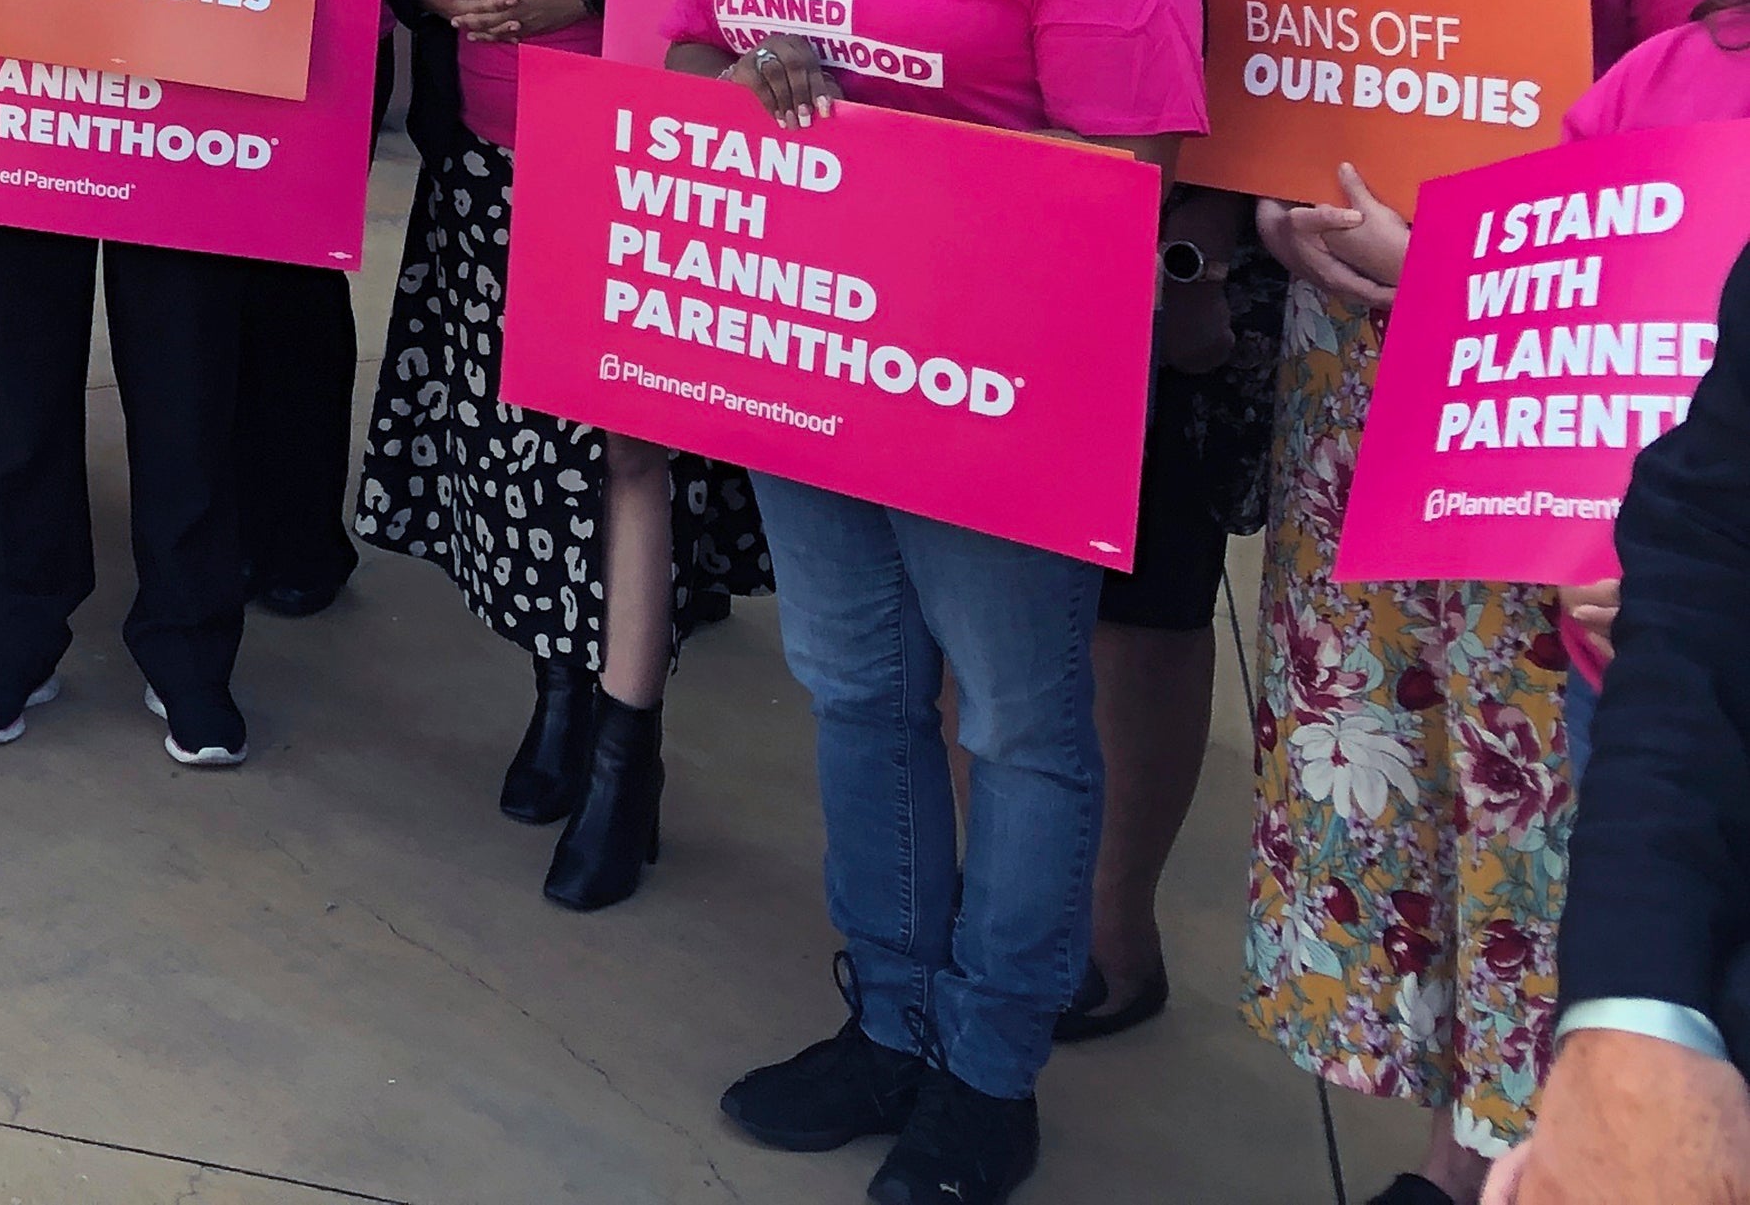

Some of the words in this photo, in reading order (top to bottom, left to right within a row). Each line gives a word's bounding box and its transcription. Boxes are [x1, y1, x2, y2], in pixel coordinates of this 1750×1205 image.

[722, 27, 932, 80] PARTHOOD
[1246, 0, 1360, 53] BANS
[1370, 10, 1461, 60] OFF
[1243, 53, 1343, 105] OUR
[1352, 63, 1542, 128] BODIES
[24, 170, 130, 199] Parenthood
[615, 108, 633, 152] I
[647, 116, 842, 193] STAND
[614, 164, 767, 239] WITH
[1473, 211, 1494, 259] I
[1498, 182, 1684, 253] STAND
[608, 222, 878, 323] PLANNED
[1467, 255, 1601, 321] WITH
[603, 278, 1015, 417] PARENTHOOD
[1448, 322, 1718, 387] PLANNED
[623, 362, 707, 402] Planned
[710, 384, 837, 437] Parenthood
[1446, 491, 1531, 516] Planned
